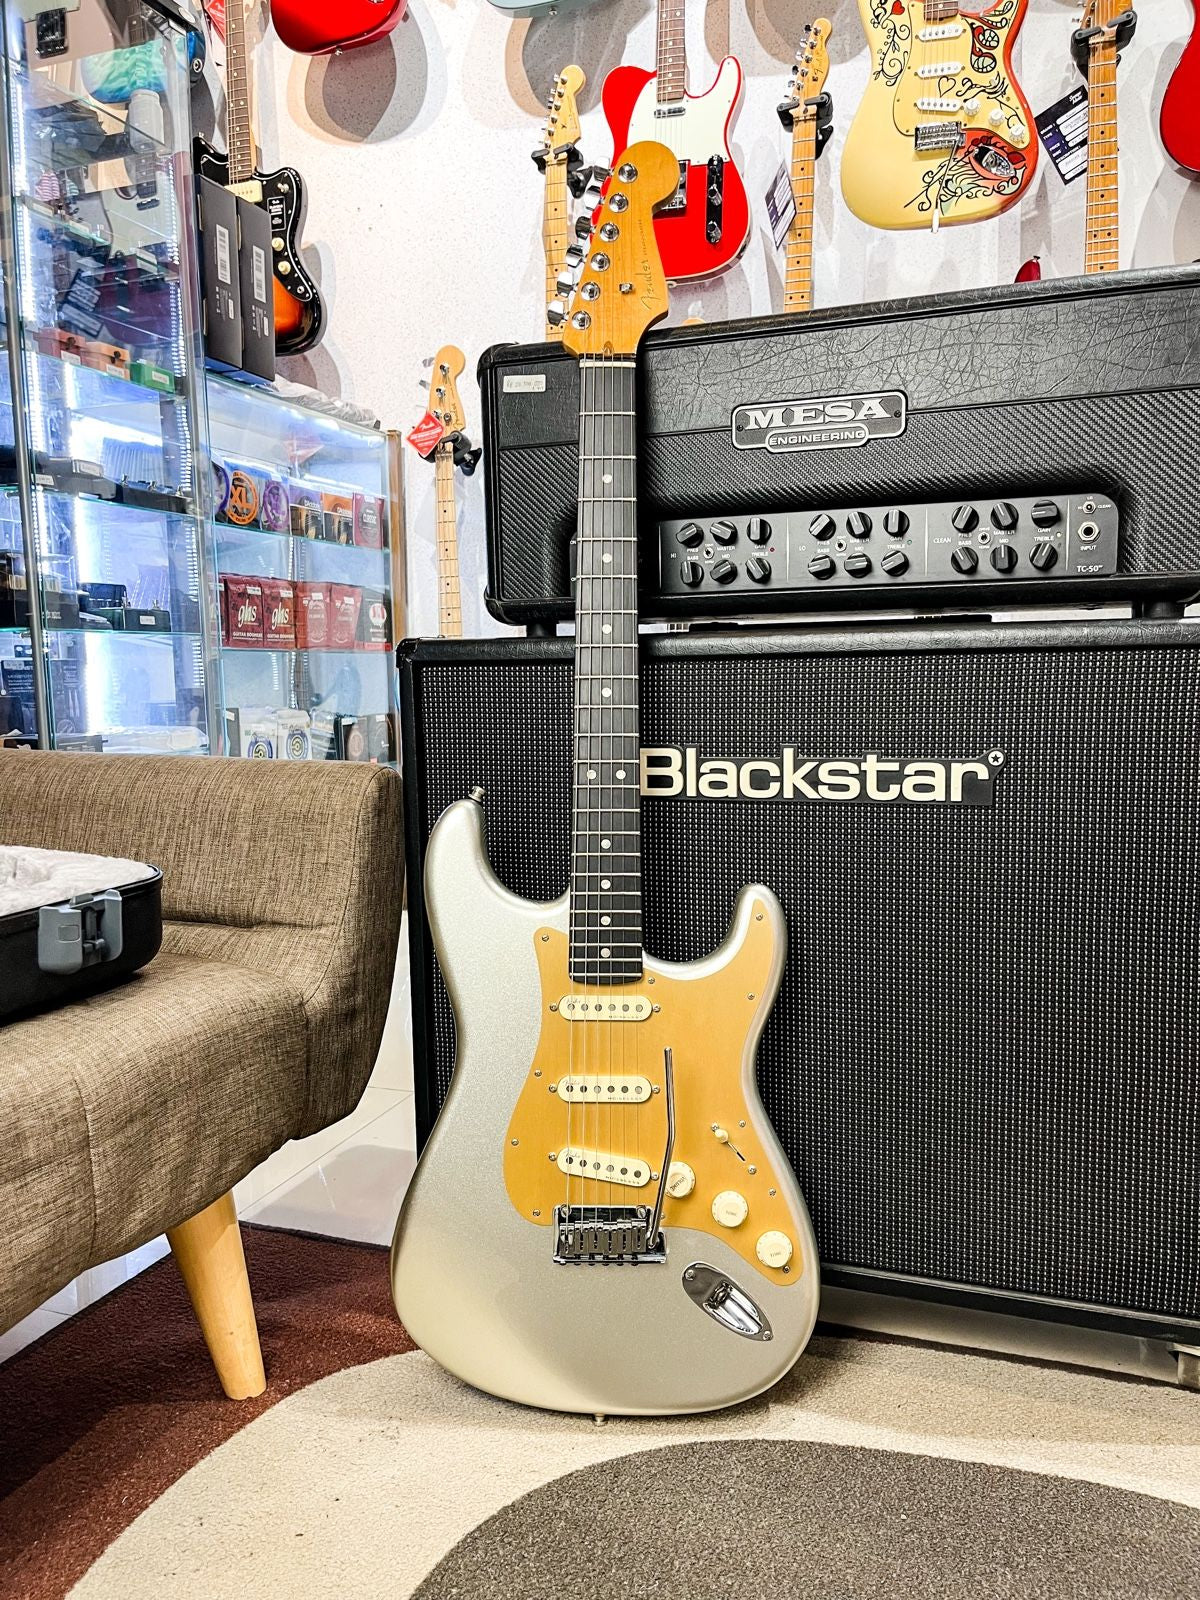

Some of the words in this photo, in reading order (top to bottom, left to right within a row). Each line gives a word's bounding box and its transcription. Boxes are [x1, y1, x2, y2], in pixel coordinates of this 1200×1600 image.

[744, 399, 892, 430] MESA
[769, 430, 866, 446] ENGINEERING
[238, 598, 257, 628] ghs
[271, 601, 290, 630] ghs
[640, 747, 989, 802] Blackstar
